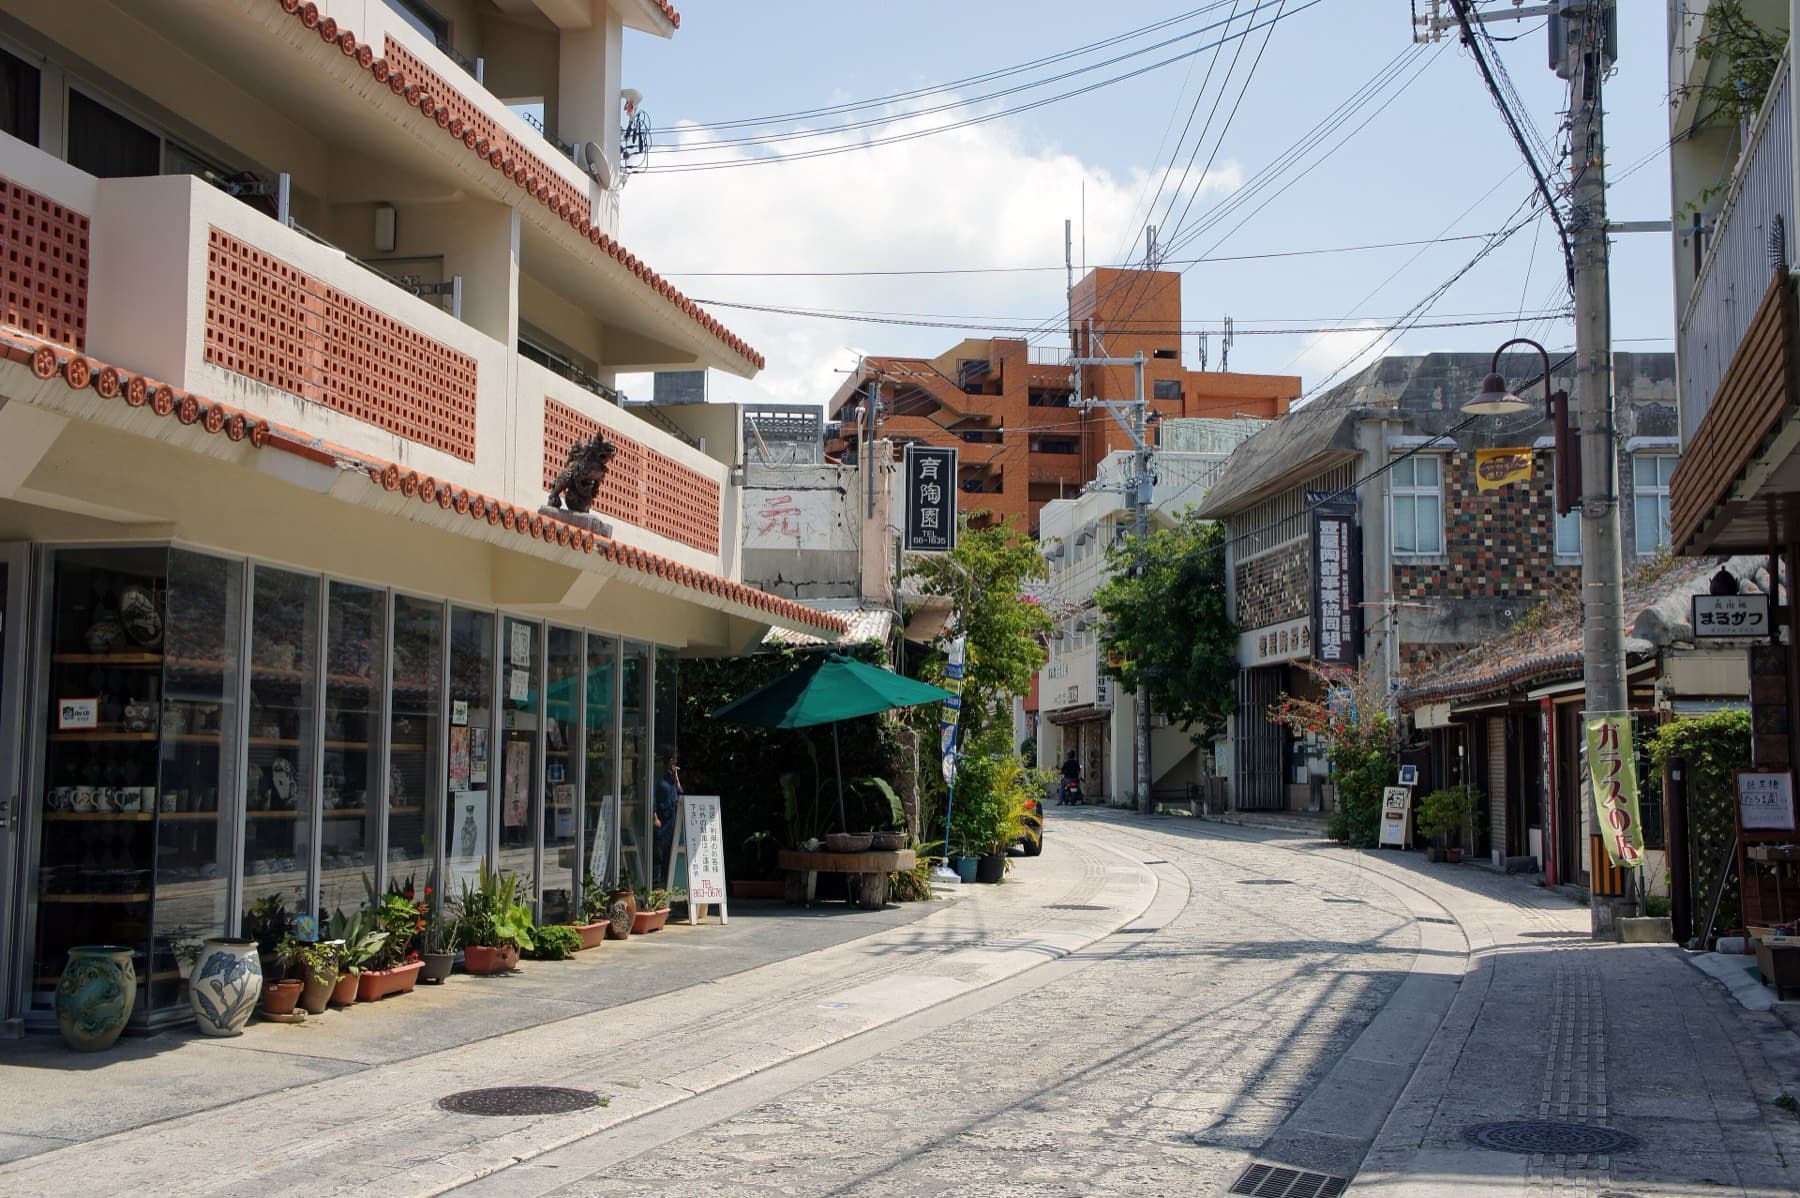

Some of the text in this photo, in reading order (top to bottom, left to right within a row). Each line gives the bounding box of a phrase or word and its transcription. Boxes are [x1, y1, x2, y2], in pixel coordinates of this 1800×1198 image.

[919, 456, 942, 529] 育陶園
[1597, 723, 1639, 860] ガラスの店
[701, 879, 712, 888] TEL
